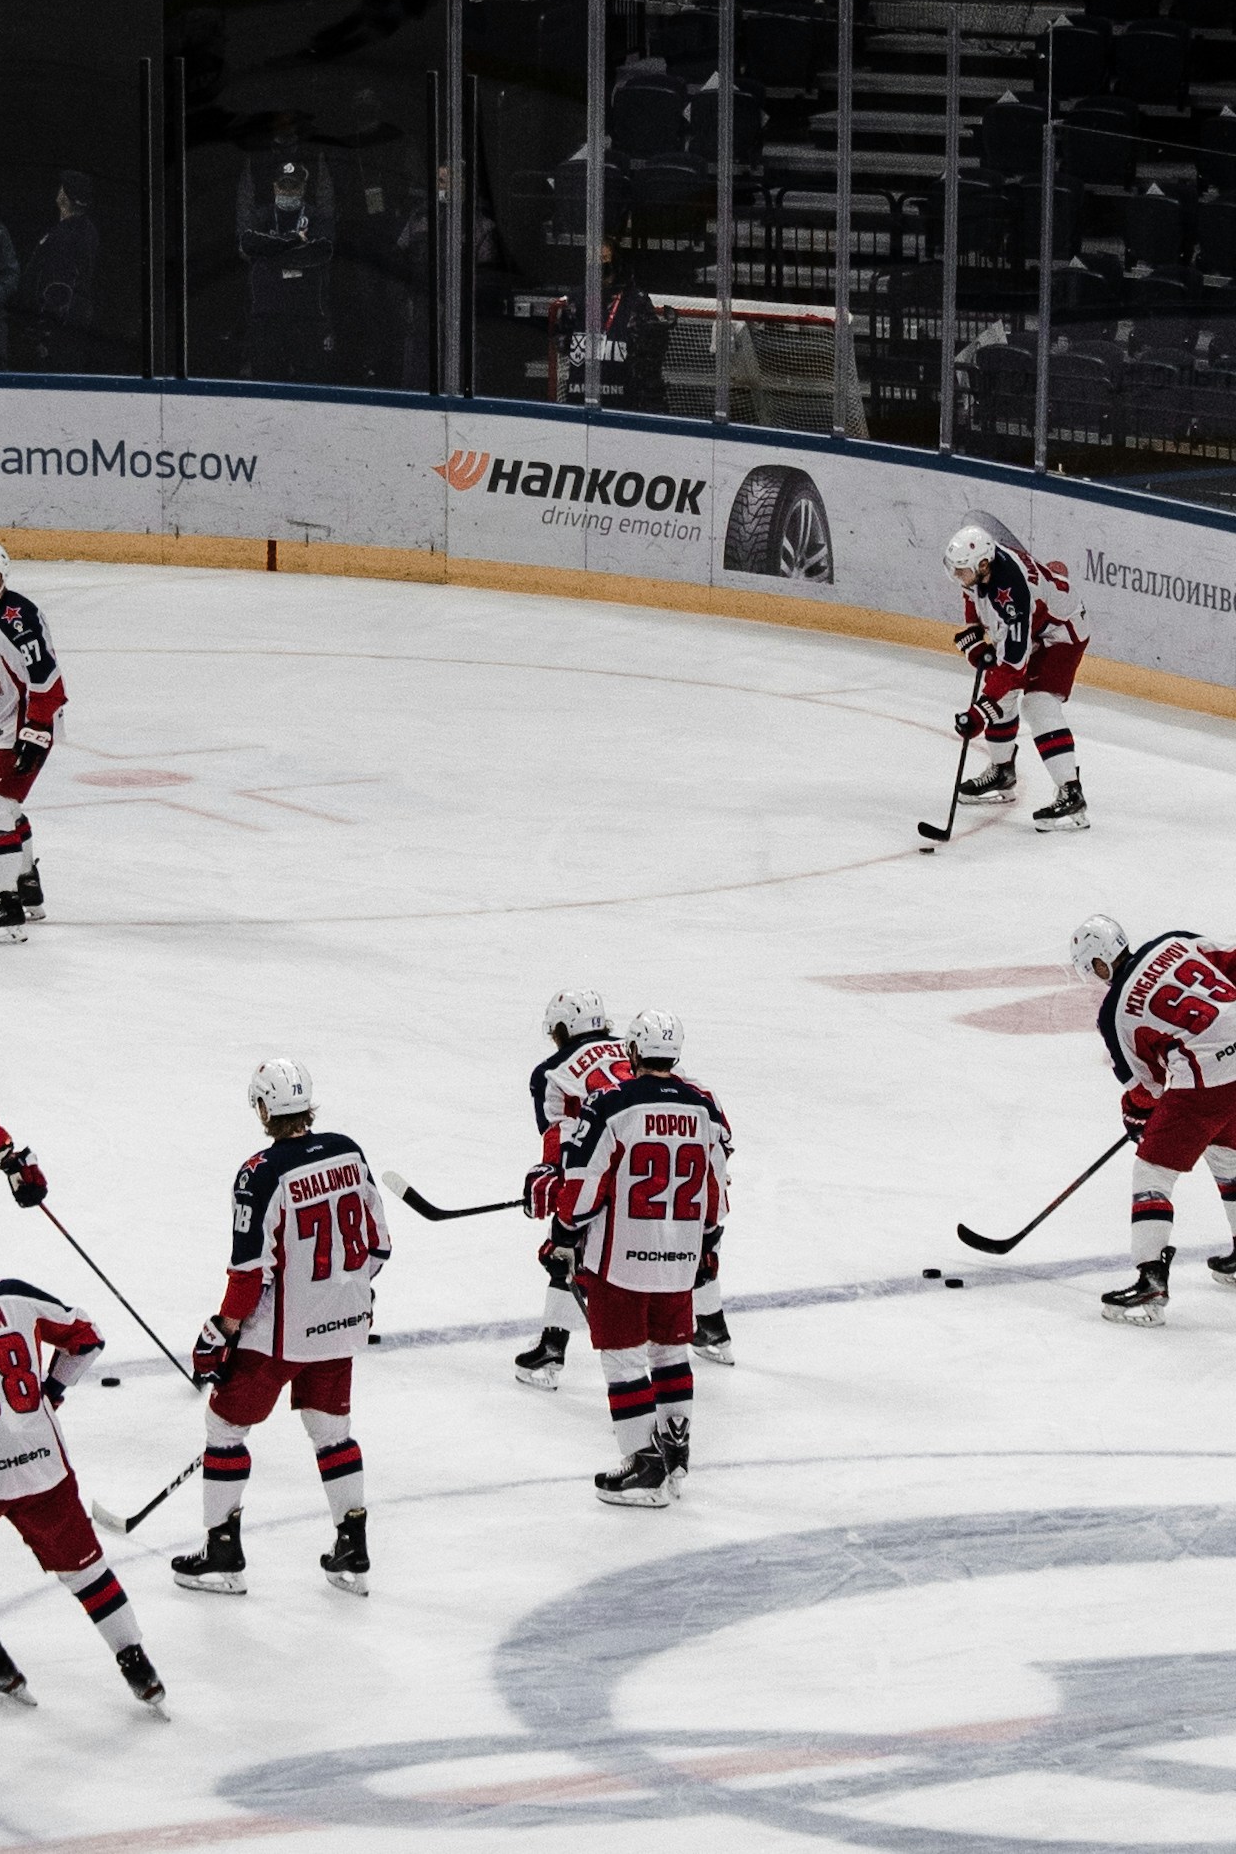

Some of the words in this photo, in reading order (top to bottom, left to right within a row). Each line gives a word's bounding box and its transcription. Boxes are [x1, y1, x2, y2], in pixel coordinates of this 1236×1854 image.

[542, 504, 614, 538] driving
[618, 516, 703, 542] emotion
[1084, 548, 1236, 613] Металлоинв
[1125, 942, 1190, 1018] MINGACHYOV
[1149, 959, 1236, 1036] 63
[662, 1028, 674, 1041] 22
[568, 1042, 627, 1079] LEIPSI
[291, 1082, 303, 1096] 78
[644, 1114, 698, 1138] POPOV
[289, 1163, 362, 1204] SHALUNOV
[628, 1142, 706, 1221] 22
[296, 1192, 370, 1282] 78
